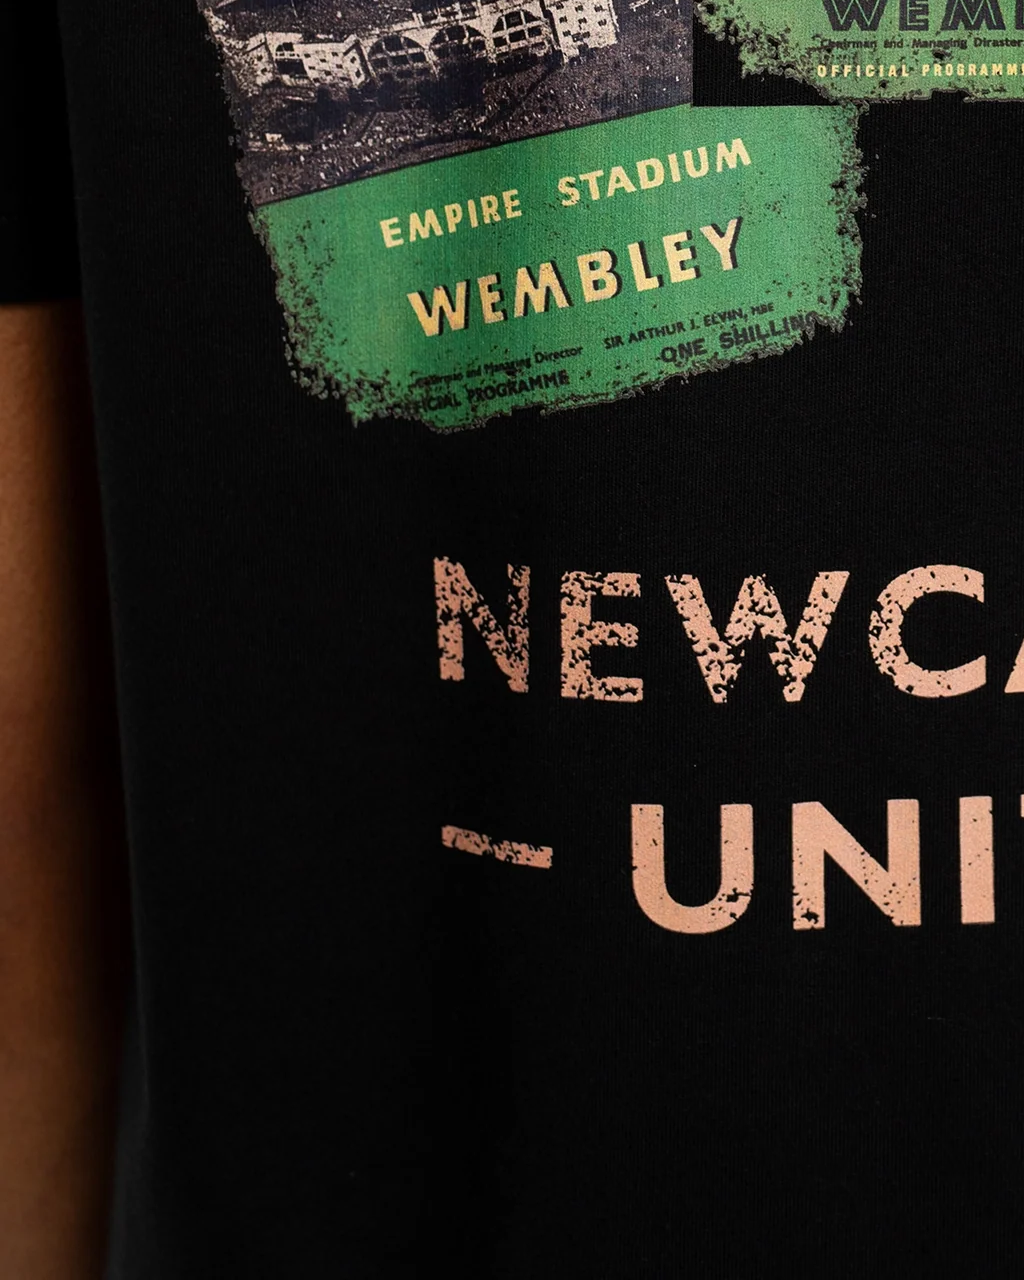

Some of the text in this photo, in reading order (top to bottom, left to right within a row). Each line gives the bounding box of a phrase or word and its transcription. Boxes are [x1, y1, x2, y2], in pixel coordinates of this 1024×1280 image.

[912, 37, 967, 50] Managing
[817, 64, 910, 78] OFFICIAL
[380, 138, 752, 249] EMPIRE STADIUM
[407, 216, 744, 338] WEMBLEY
[535, 346, 584, 365] Director
[603, 335, 625, 350] SIR
[628, 321, 687, 343] ARTHUR
[660, 337, 708, 363] ONE
[466, 370, 570, 404] PROGRAMME
